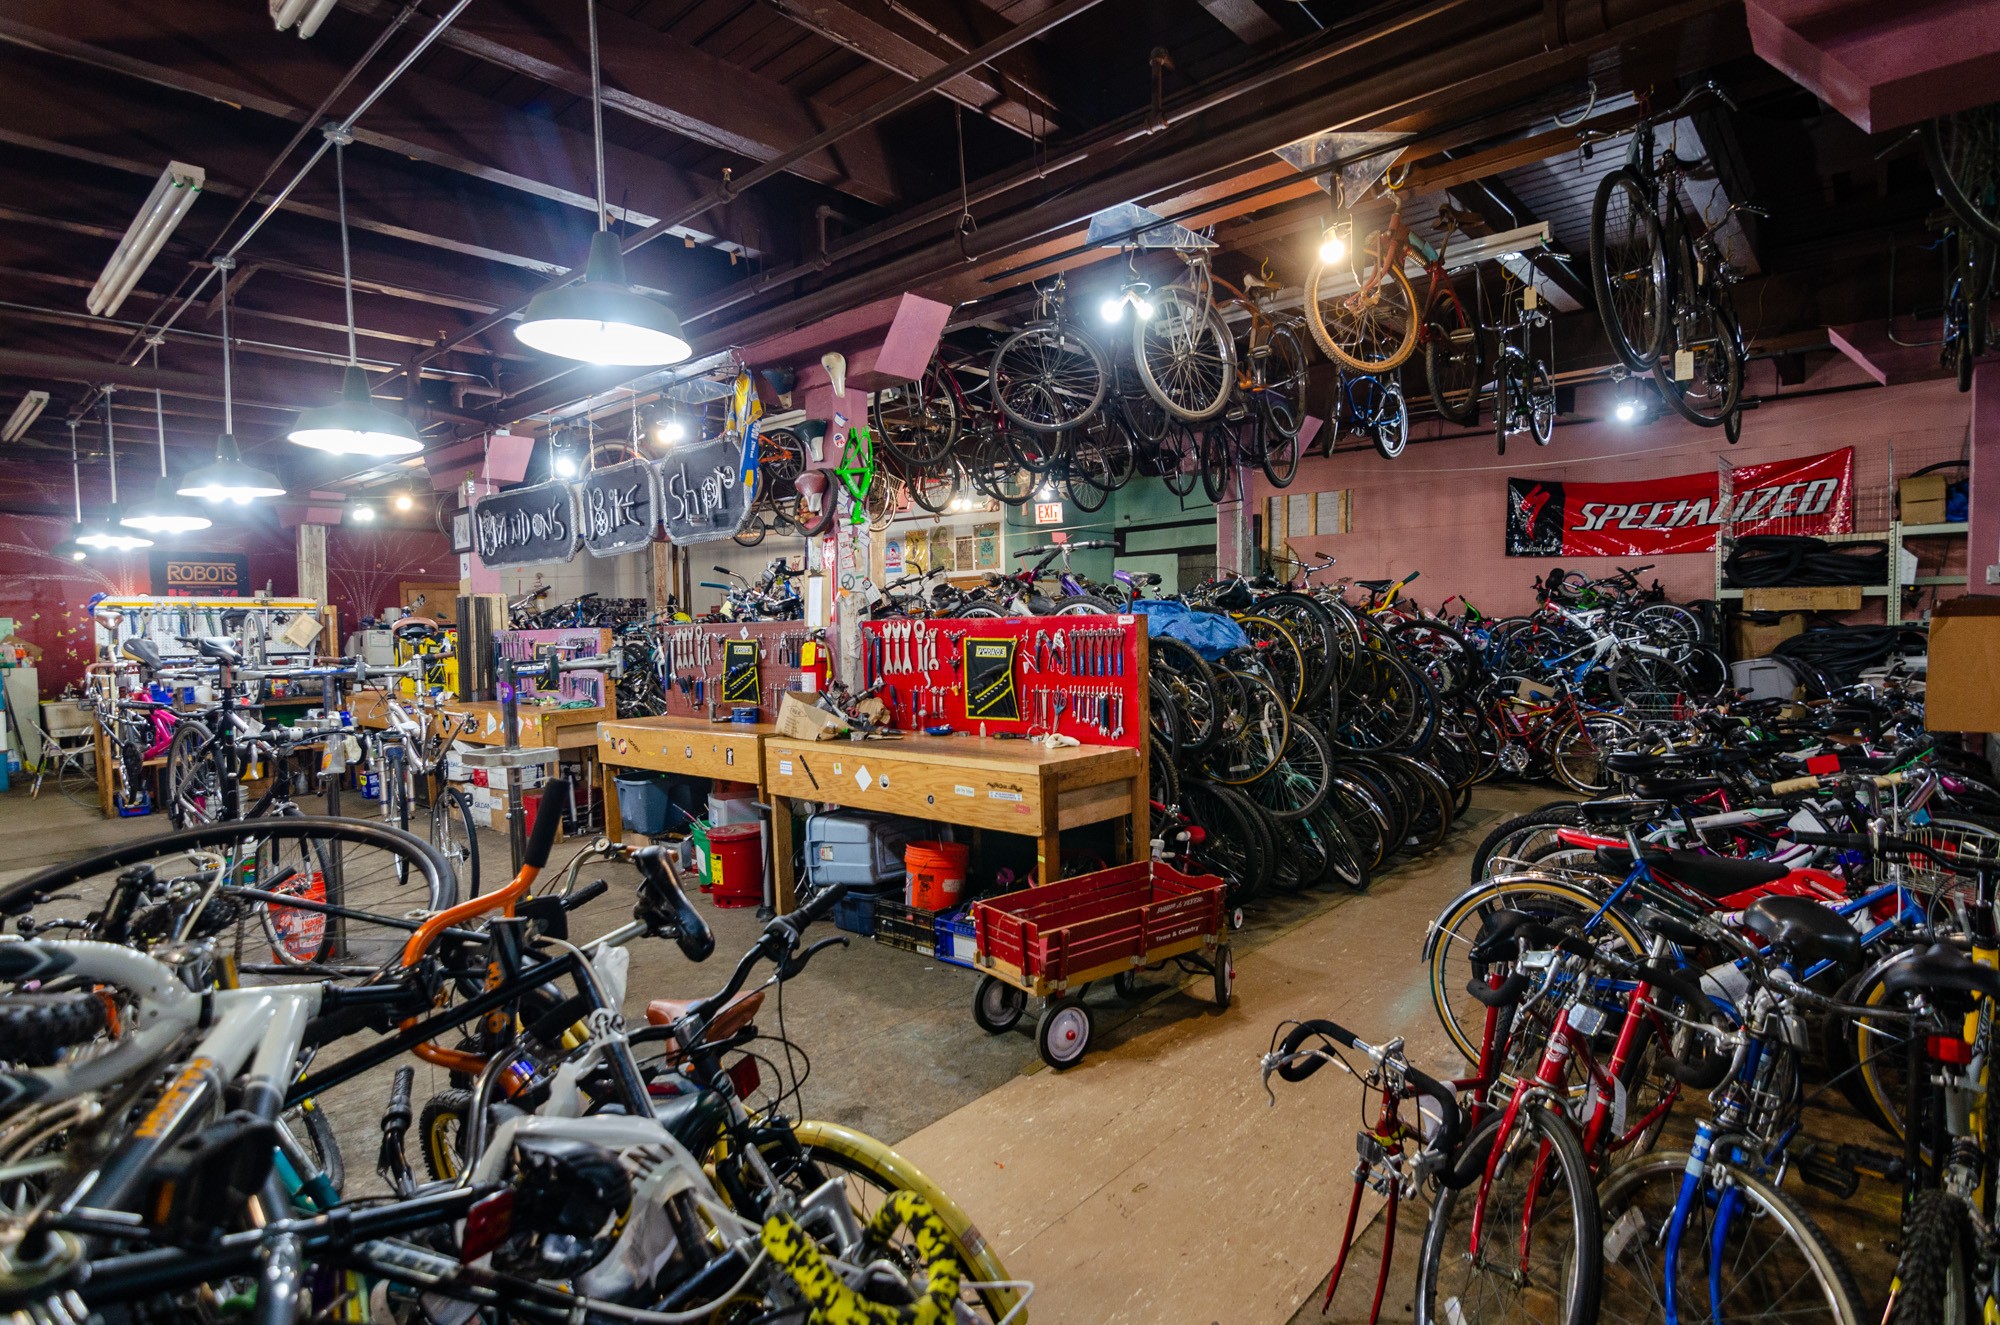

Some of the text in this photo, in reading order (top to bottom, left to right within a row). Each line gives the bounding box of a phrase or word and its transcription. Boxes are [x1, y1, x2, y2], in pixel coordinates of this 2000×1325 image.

[1038, 504, 1059, 519] EXIT
[1571, 477, 1839, 532] SPECIALIZED
[167, 565, 238, 582] ROBOTS
[1155, 933, 1171, 942] Town
[1178, 925, 1200, 936] Country
